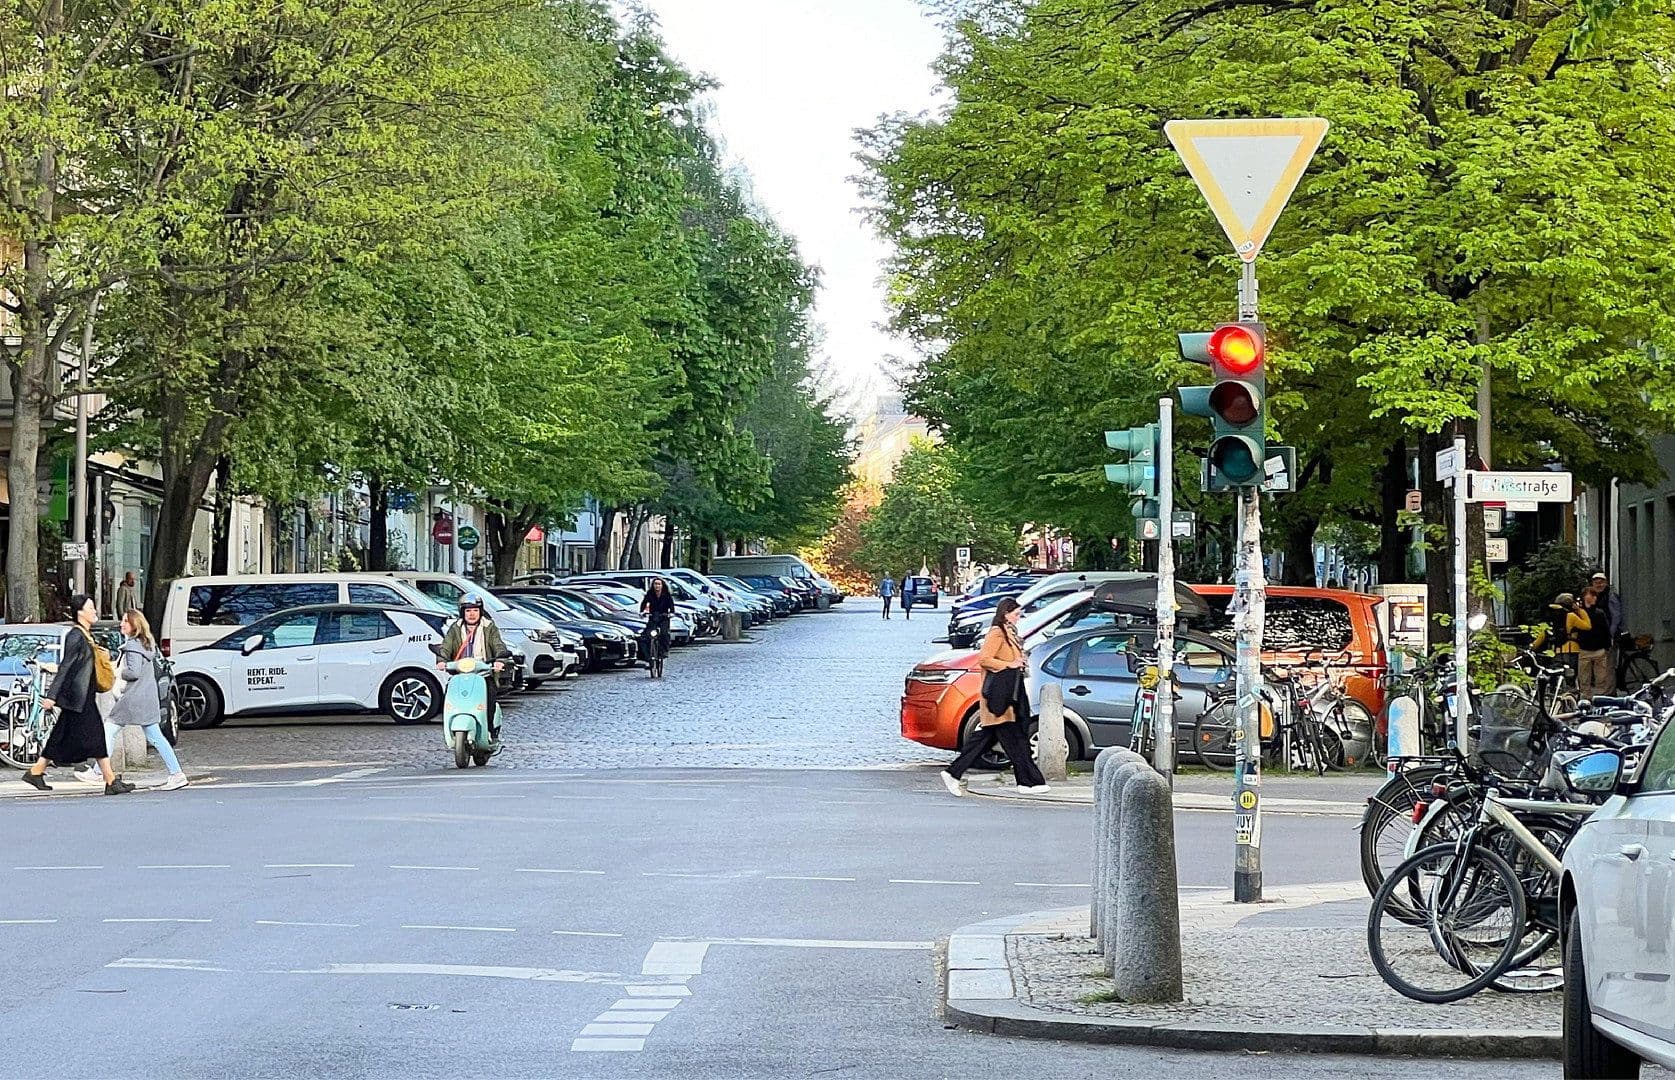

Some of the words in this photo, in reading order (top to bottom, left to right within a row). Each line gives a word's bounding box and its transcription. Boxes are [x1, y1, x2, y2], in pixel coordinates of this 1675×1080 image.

[408, 634, 432, 643] MILES
[247, 668, 267, 676] RENT.
[269, 667, 287, 675] RIDE.
[248, 677, 276, 685] REPEAT.
